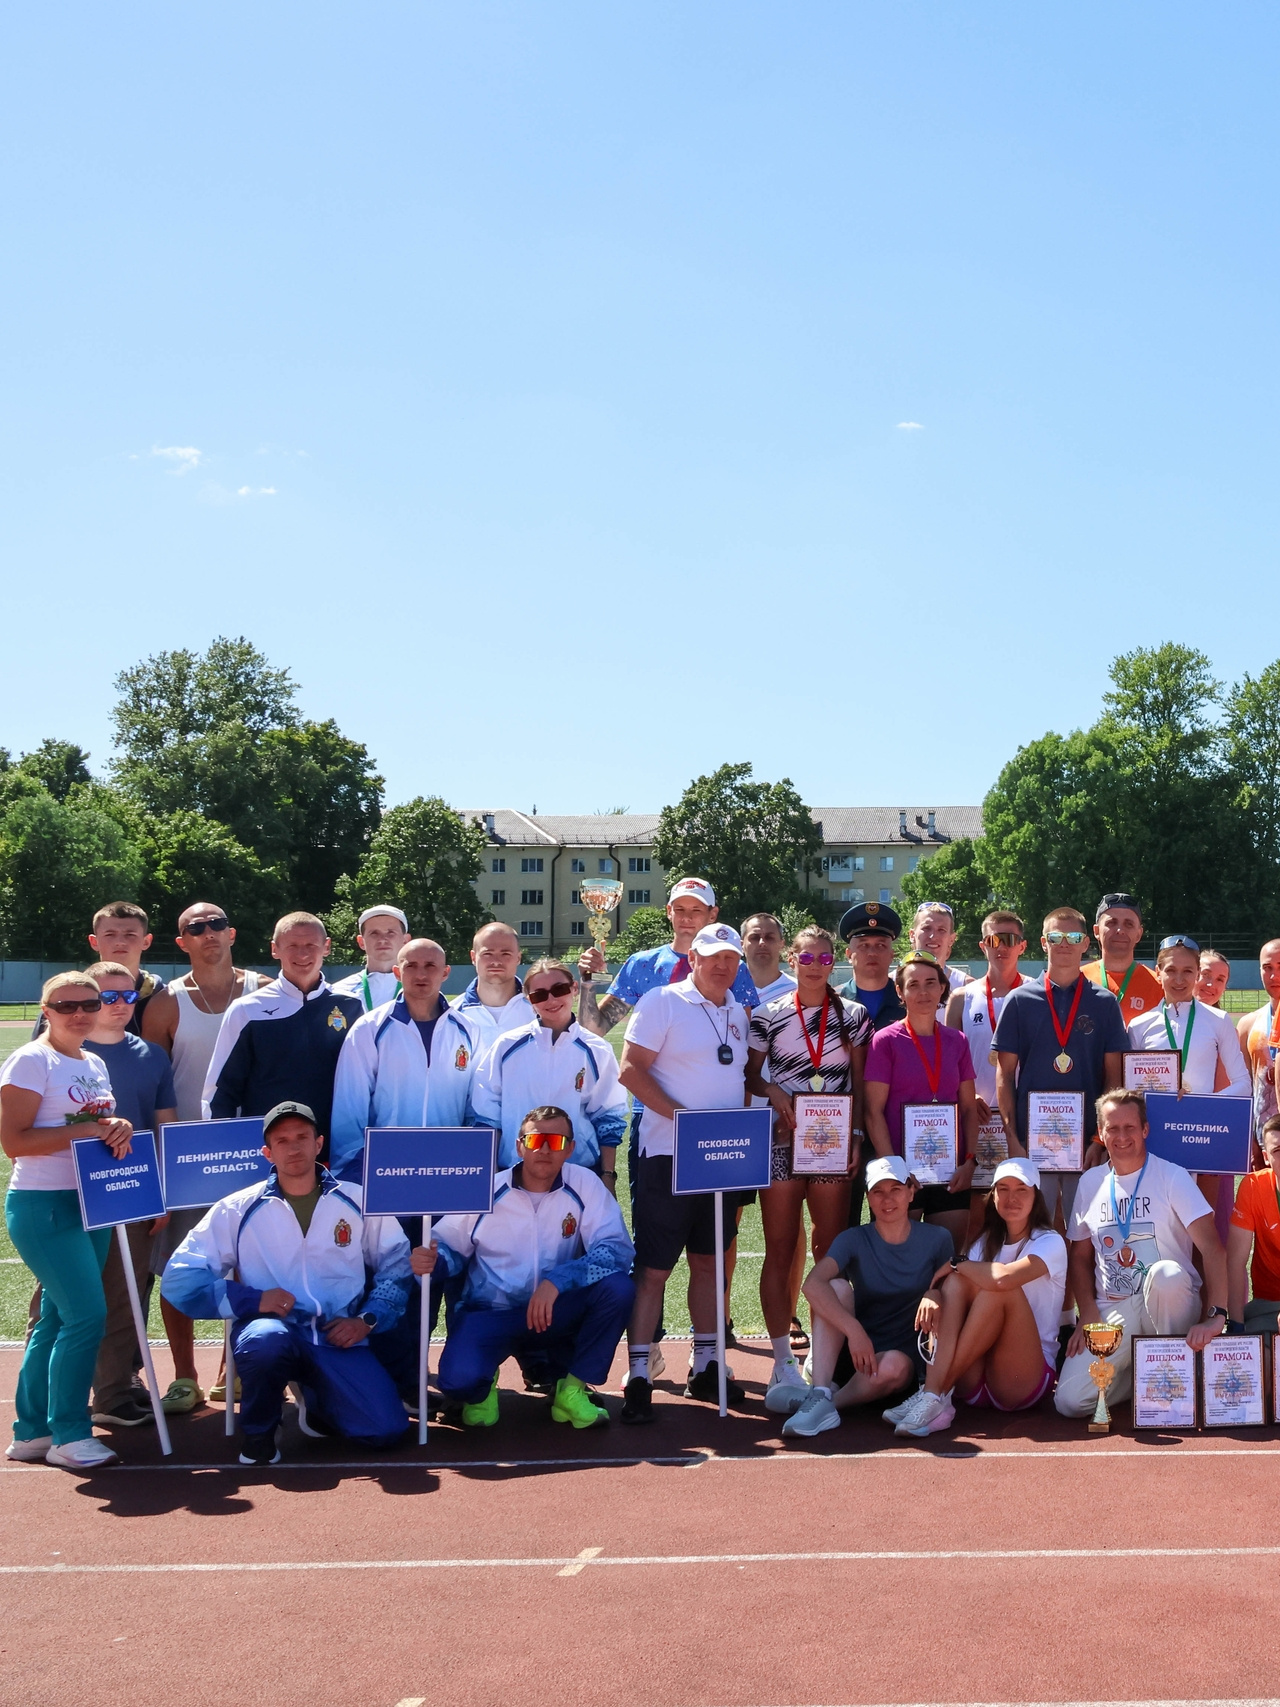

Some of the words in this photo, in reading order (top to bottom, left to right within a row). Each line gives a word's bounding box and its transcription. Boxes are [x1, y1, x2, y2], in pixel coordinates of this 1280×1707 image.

[1133, 1066, 1170, 1075] ГРАМОТА
[804, 1108, 842, 1117] ГРАМОТА
[1038, 1105, 1075, 1114] ГРАМОТА
[913, 1118, 948, 1127] ГРАМОТА
[1164, 1122, 1230, 1134] РЕСПУБЛИКА
[697, 1138, 751, 1149] ПСКОВСКАЯ
[1181, 1135, 1211, 1145] КОМИ
[176, 1149, 264, 1164] ЛЕНИНГРАДСК
[704, 1151, 746, 1161] ОБЛАСТЬ
[89, 1164, 149, 1181] НОВГОРОДСКАЯ
[202, 1162, 259, 1175] ОБЛАСТЬ
[375, 1166, 483, 1177] САНКТ-ПЕТЕРБУРГ
[105, 1179, 140, 1192] ОБЛАСТЬ
[1145, 1354, 1186, 1363] ДИПЛОМ
[1213, 1351, 1253, 1362] ГРАМОТА
